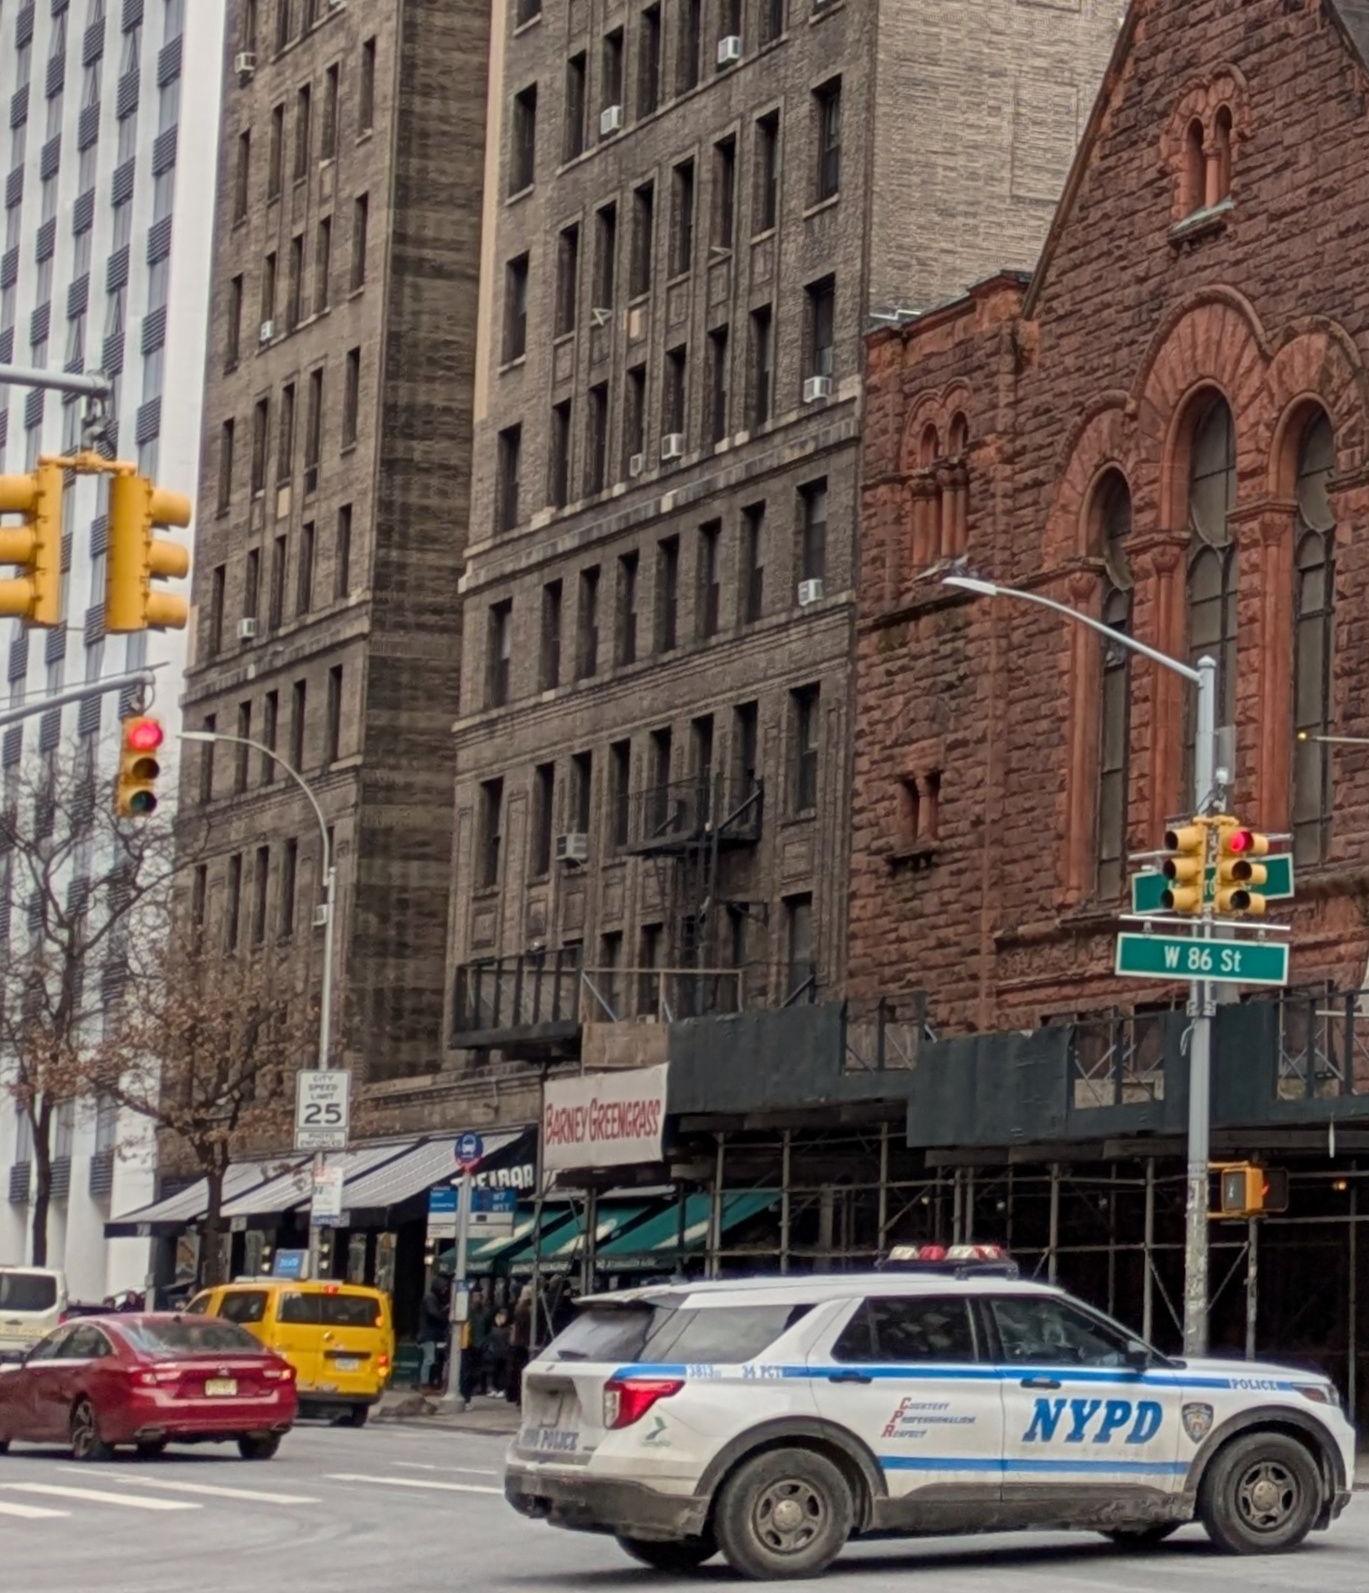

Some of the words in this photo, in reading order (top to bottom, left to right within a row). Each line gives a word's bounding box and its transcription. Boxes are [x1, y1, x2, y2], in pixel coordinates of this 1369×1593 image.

[1164, 945, 1180, 968] W
[1187, 946, 1213, 971] 86
[1220, 949, 1242, 972] St
[304, 1103, 342, 1124] 25
[546, 1103, 587, 1145] BARNEY
[589, 1098, 661, 1142] GREENGRASS
[1231, 1378, 1277, 1391] POLICE
[1022, 1398, 1163, 1444] NYPD
